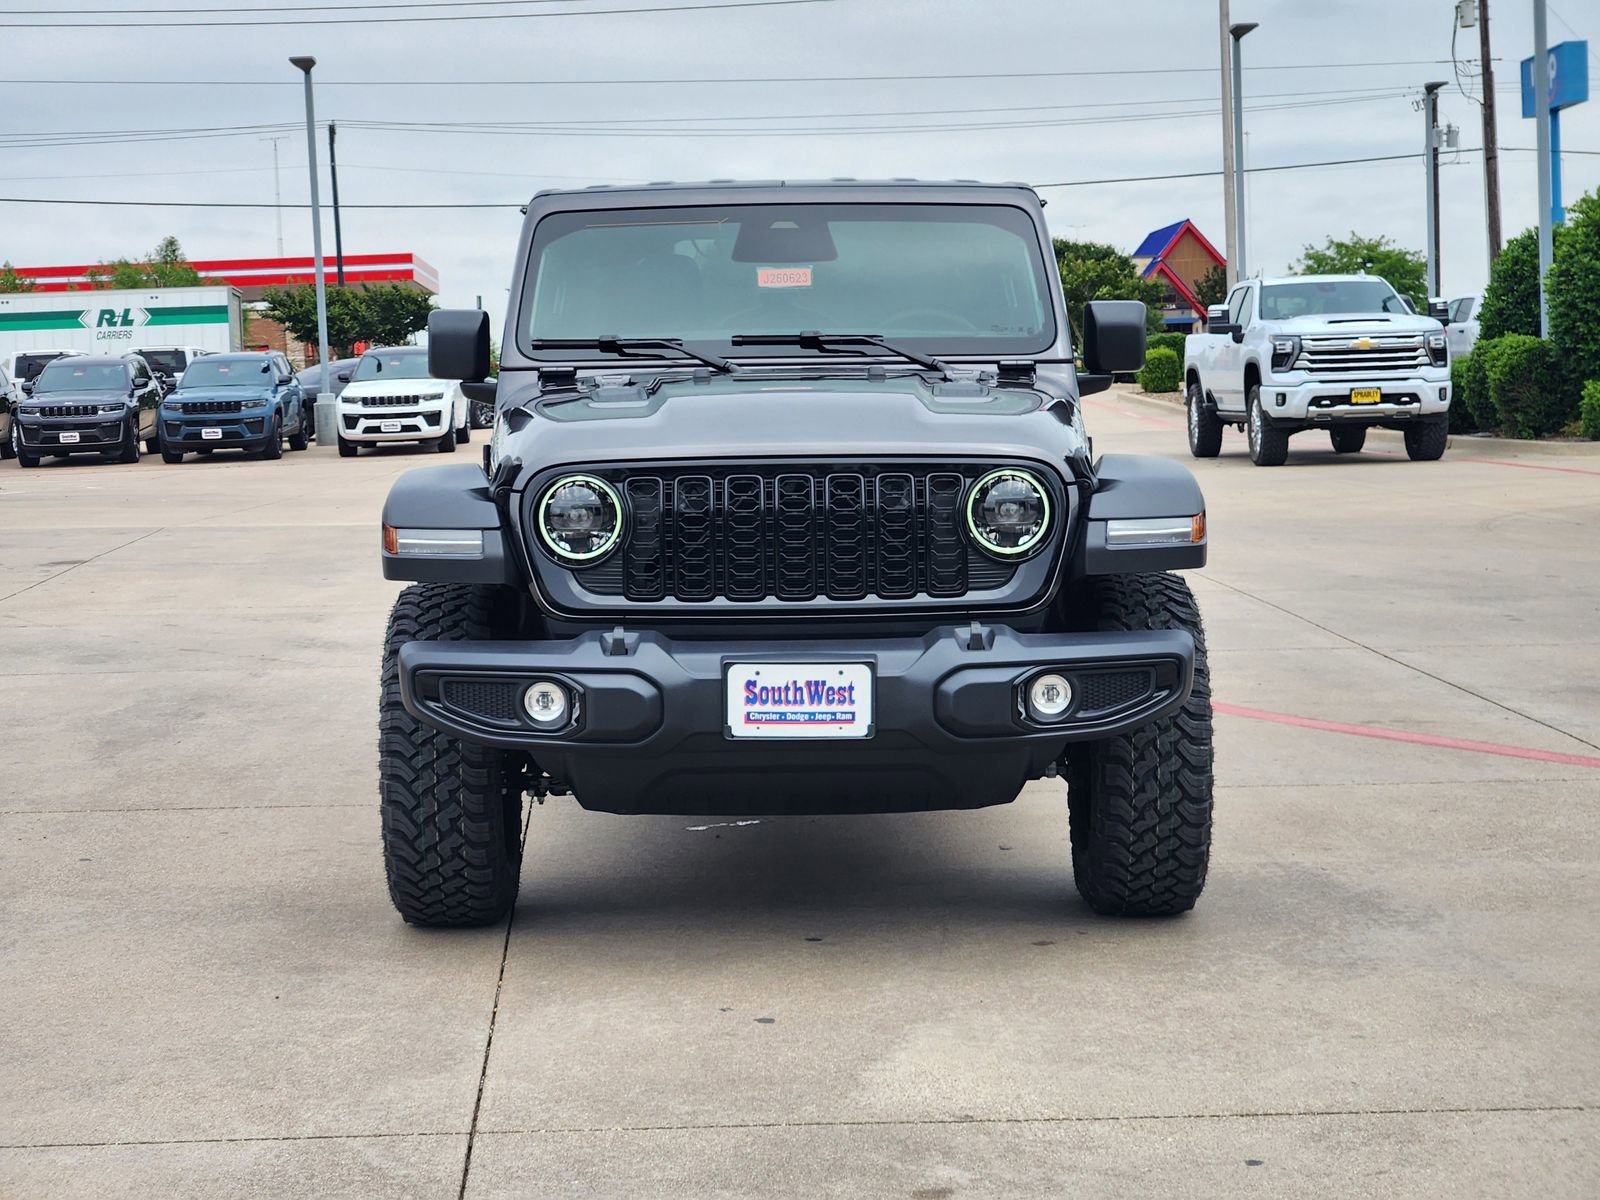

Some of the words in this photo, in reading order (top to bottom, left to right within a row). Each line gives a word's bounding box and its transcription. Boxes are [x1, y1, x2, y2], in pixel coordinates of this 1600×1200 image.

[763, 272, 808, 284] J260623
[96, 330, 133, 340] CARRIERS
[744, 679, 856, 706] SouthWest
[749, 712, 780, 721] Chrysler
[786, 712, 809, 721] Dodge
[815, 712, 832, 721] Jeep
[835, 712, 853, 721] Ram
